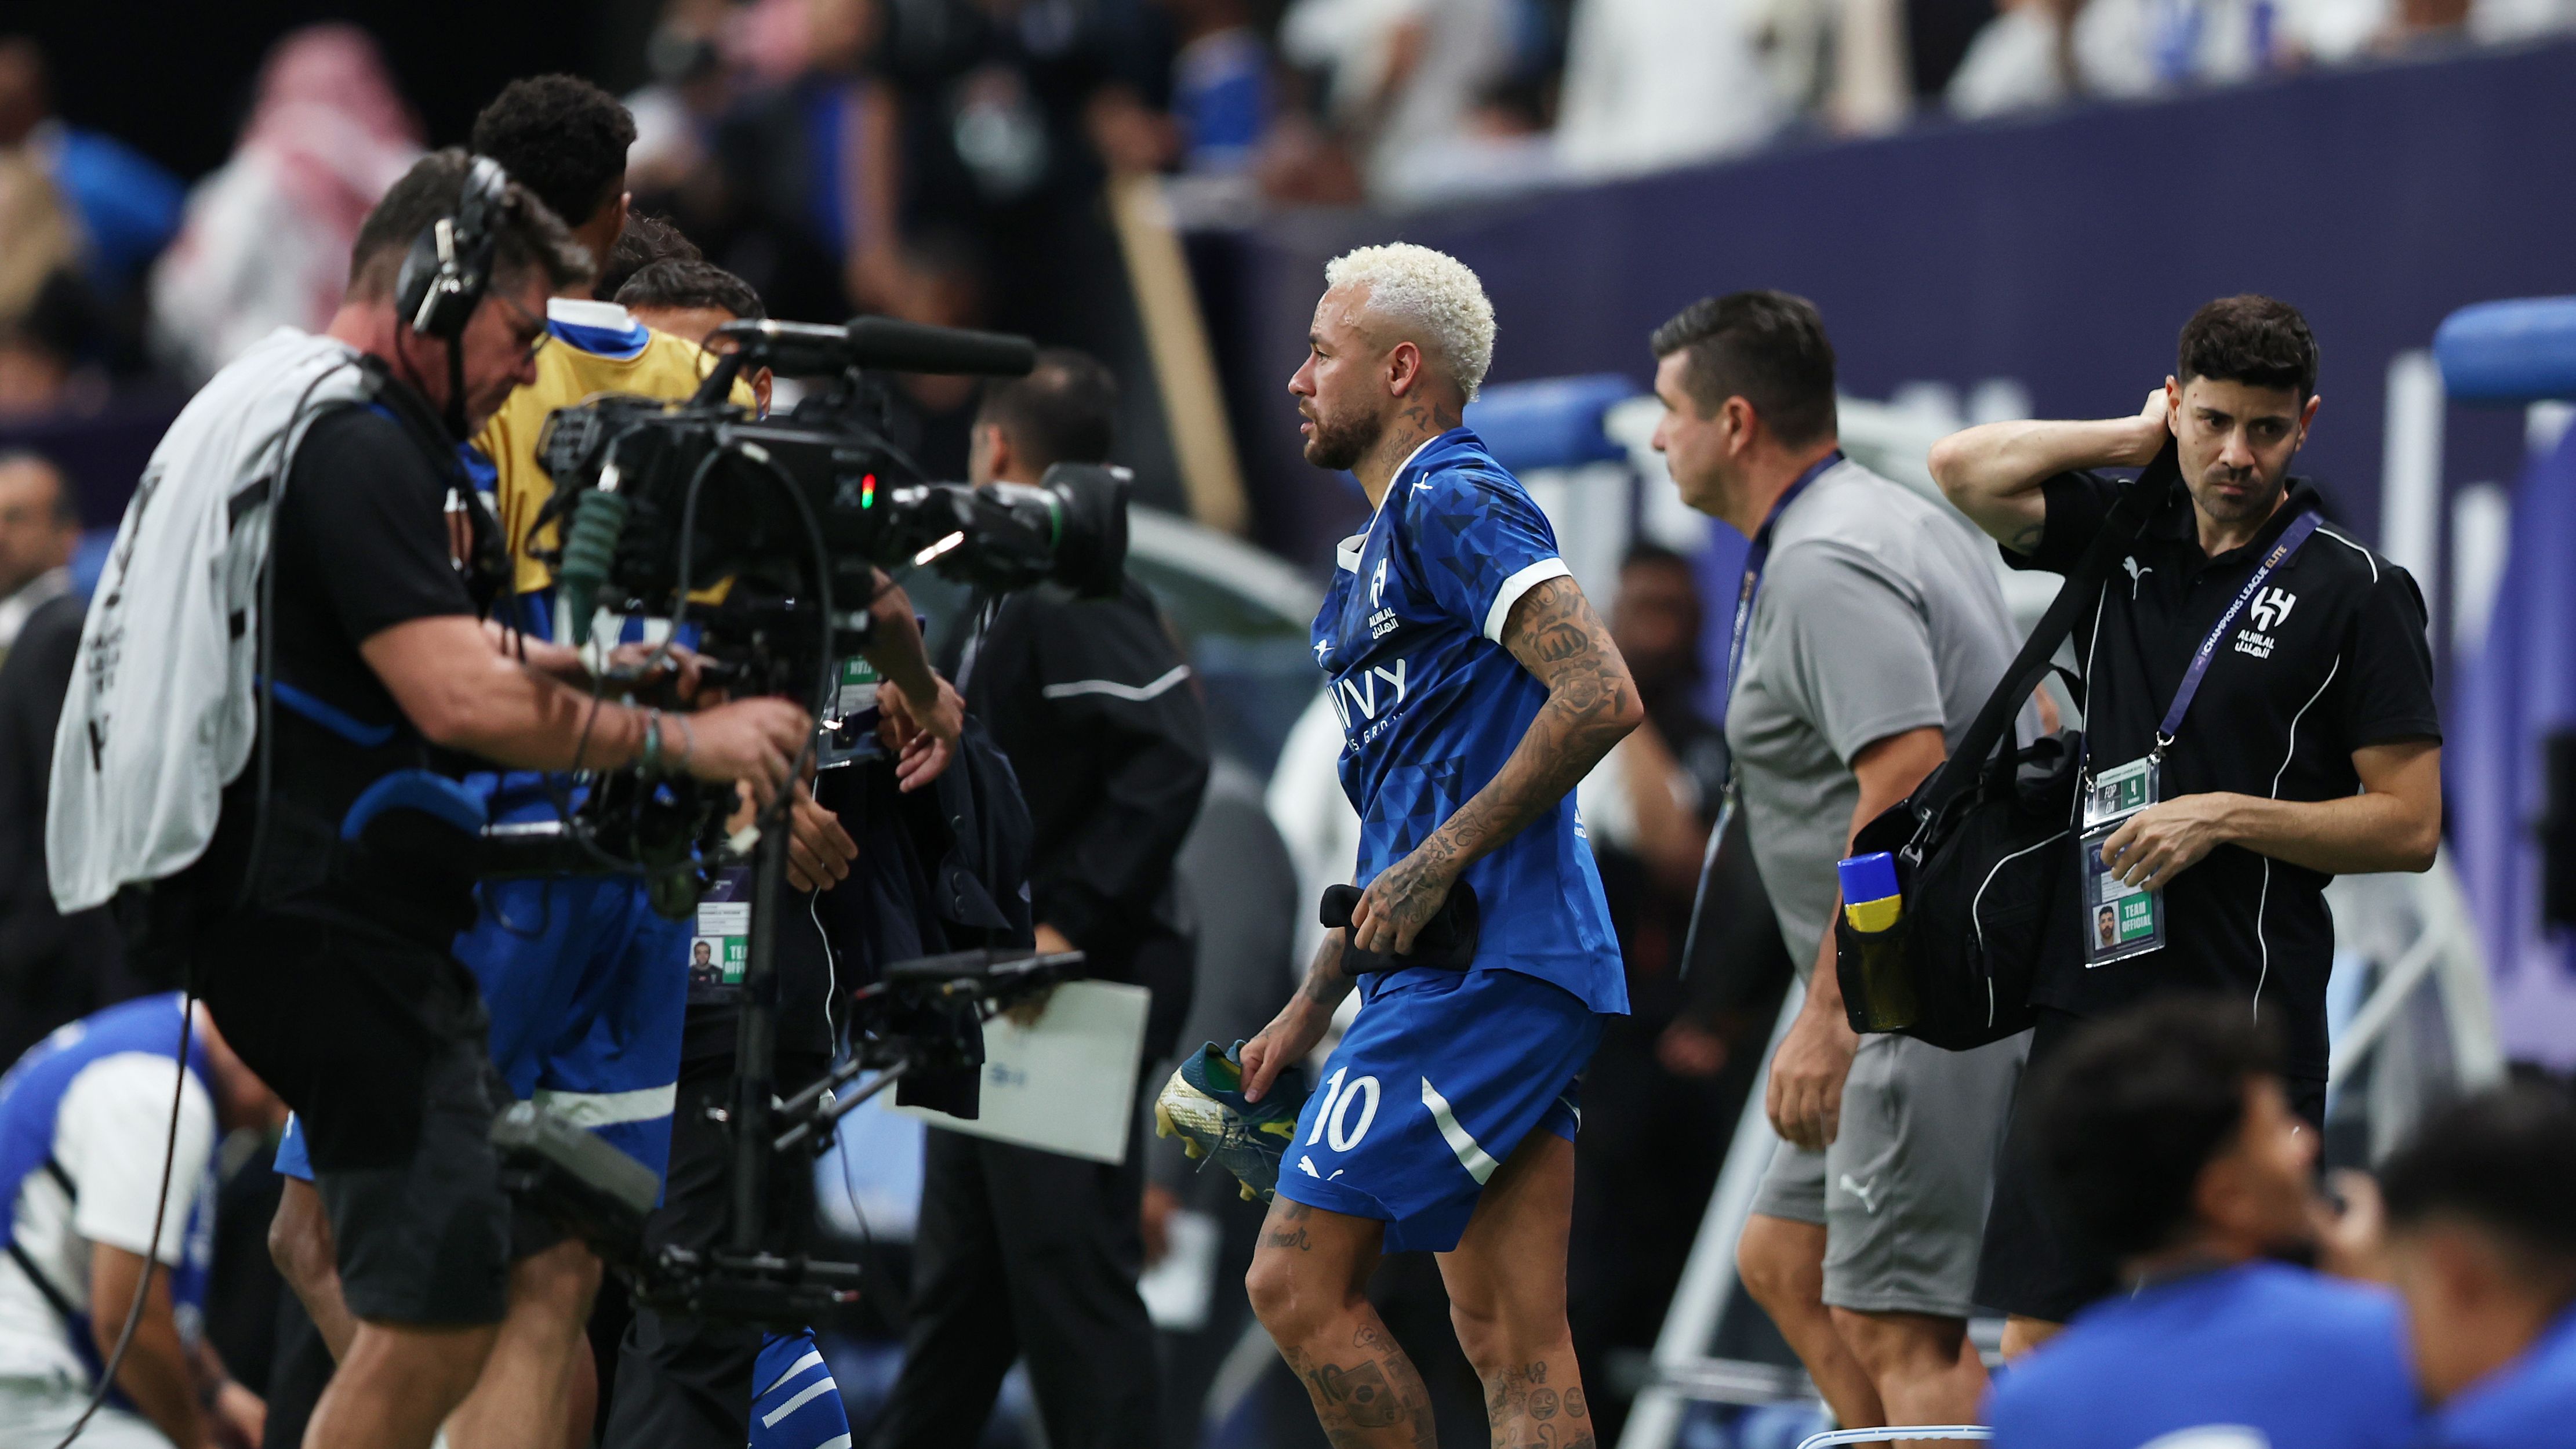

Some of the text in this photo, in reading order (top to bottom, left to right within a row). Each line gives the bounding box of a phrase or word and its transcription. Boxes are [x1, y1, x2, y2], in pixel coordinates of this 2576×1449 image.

[2203, 543, 2287, 653] CHAMPIONS LEAGUE ELITE
[1369, 607, 1396, 628] ALHILAL
[1372, 618, 1399, 640] الهلال
[2237, 629, 2275, 649] ALHILAL
[2104, 784, 2117, 800] FOP
[2131, 779, 2137, 796] 4
[2124, 900, 2146, 918] TEAM
[2121, 914, 2151, 933] OFFICIAL
[1305, 1066, 1380, 1152] 10
